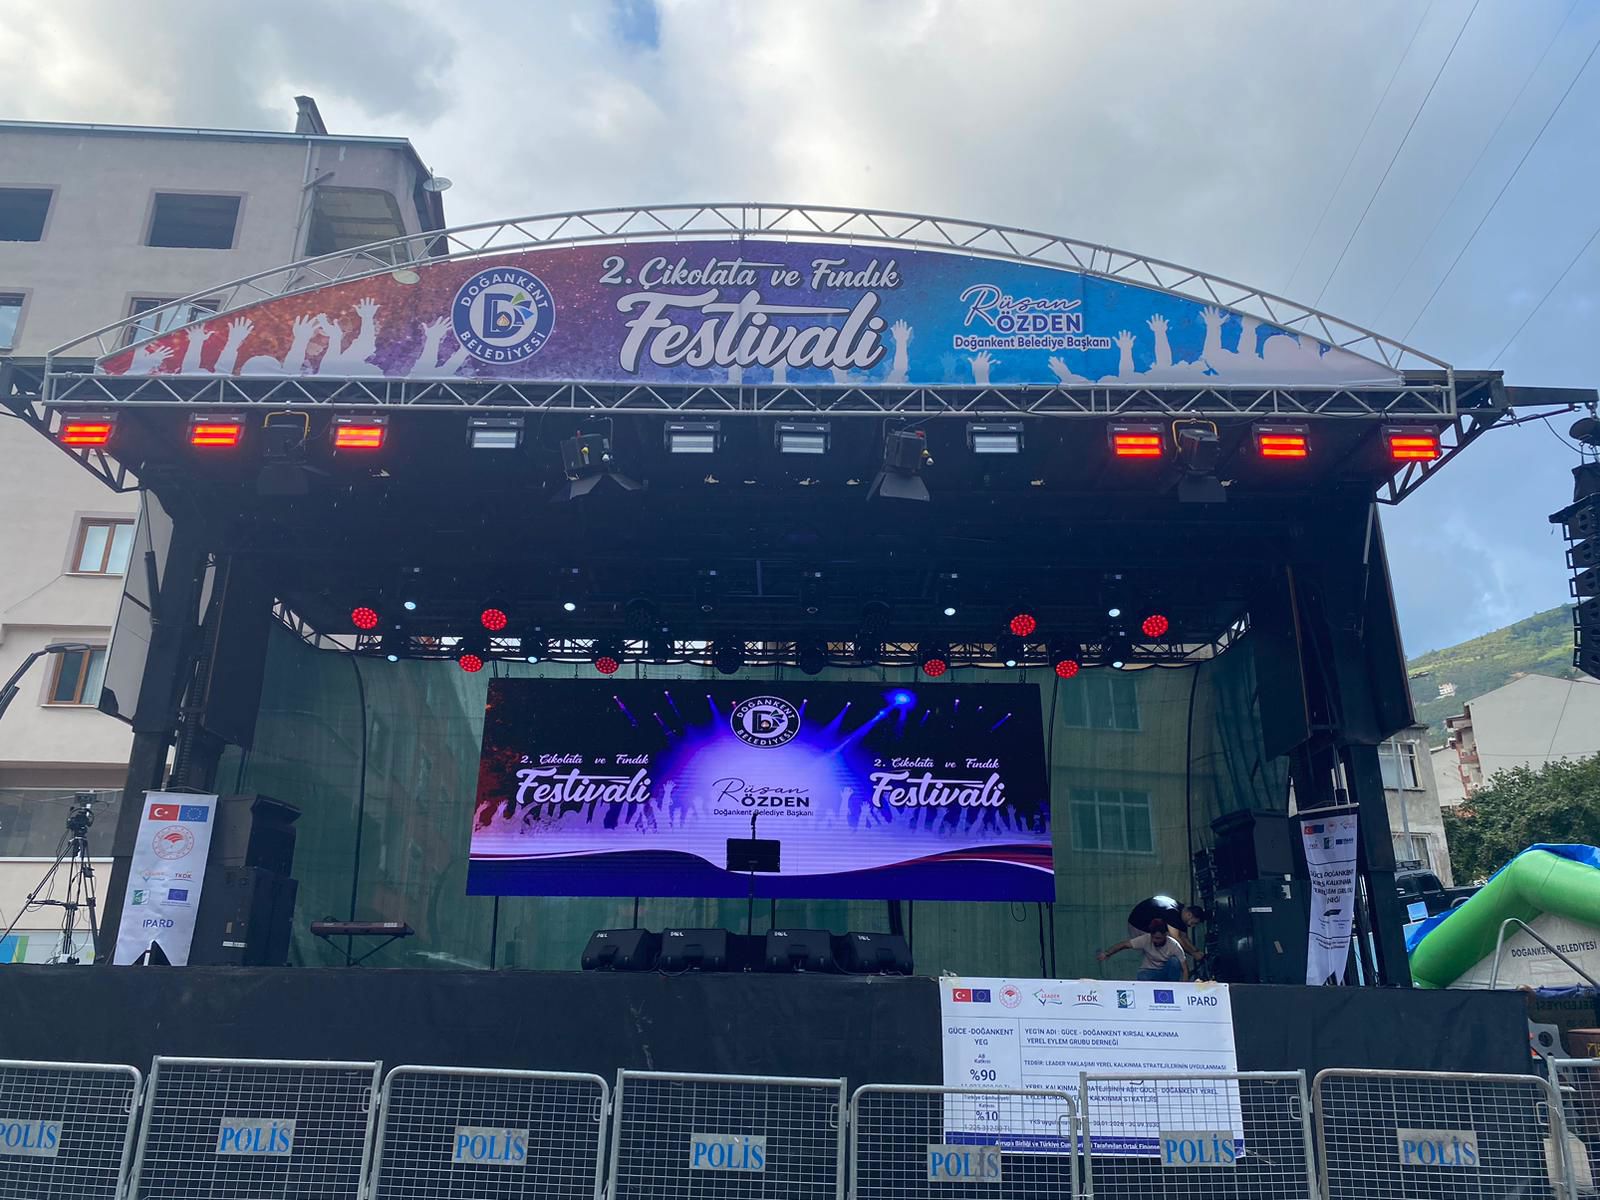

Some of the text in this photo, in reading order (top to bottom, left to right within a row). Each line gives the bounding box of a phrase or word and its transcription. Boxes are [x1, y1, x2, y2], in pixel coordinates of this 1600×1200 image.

[600, 256, 899, 290] 2. Çikolata ve Fındık
[460, 273, 548, 308] DOĞANKENT
[960, 284, 1082, 326] Rüsan
[616, 288, 885, 373] Festivali
[996, 311, 1082, 334] ÖZDEN
[460, 330, 546, 361] BELEDİYESİ
[954, 335, 1110, 351] Doğankent Belediye Başkanı
[520, 755, 533, 764] 2.
[539, 753, 583, 765] Çikolata
[616, 753, 649, 765] Fındık
[874, 758, 886, 767] 2.
[891, 757, 934, 768] Çikolata
[966, 758, 1000, 769] Fındık
[516, 767, 652, 804] Festivali
[712, 777, 809, 802] Rüsan
[869, 771, 1006, 807] Festivali
[741, 793, 810, 808] ÖZDEN
[713, 808, 752, 817] Doğankent
[786, 809, 814, 818] Başkanı
[142, 919, 174, 928] IPARD
[1077, 994, 1098, 1002] TKDK
[1187, 996, 1218, 1007] IPARD
[948, 1027, 967, 1035] GÜCE
[1061, 1028, 1077, 1036] GÜCE
[1082, 1028, 1121, 1037] DOĞANKENT
[974, 1038, 989, 1046] YEG
[1069, 1038, 1091, 1046] GRUBU
[1091, 1038, 1119, 1047] DERNEĞİ
[969, 1068, 997, 1082] %90
[1045, 1084, 1078, 1092] KALKINMA
[975, 1110, 999, 1122] %10
[220, 1122, 292, 1153] POLİS
[456, 1130, 526, 1161] POLİS
[1040, 1141, 1059, 1149] Türkiye
[693, 1137, 764, 1170] POLİS
[1164, 1133, 1236, 1164] POLİS
[1402, 1136, 1477, 1166] POLİS
[931, 1149, 999, 1177] POLİS
